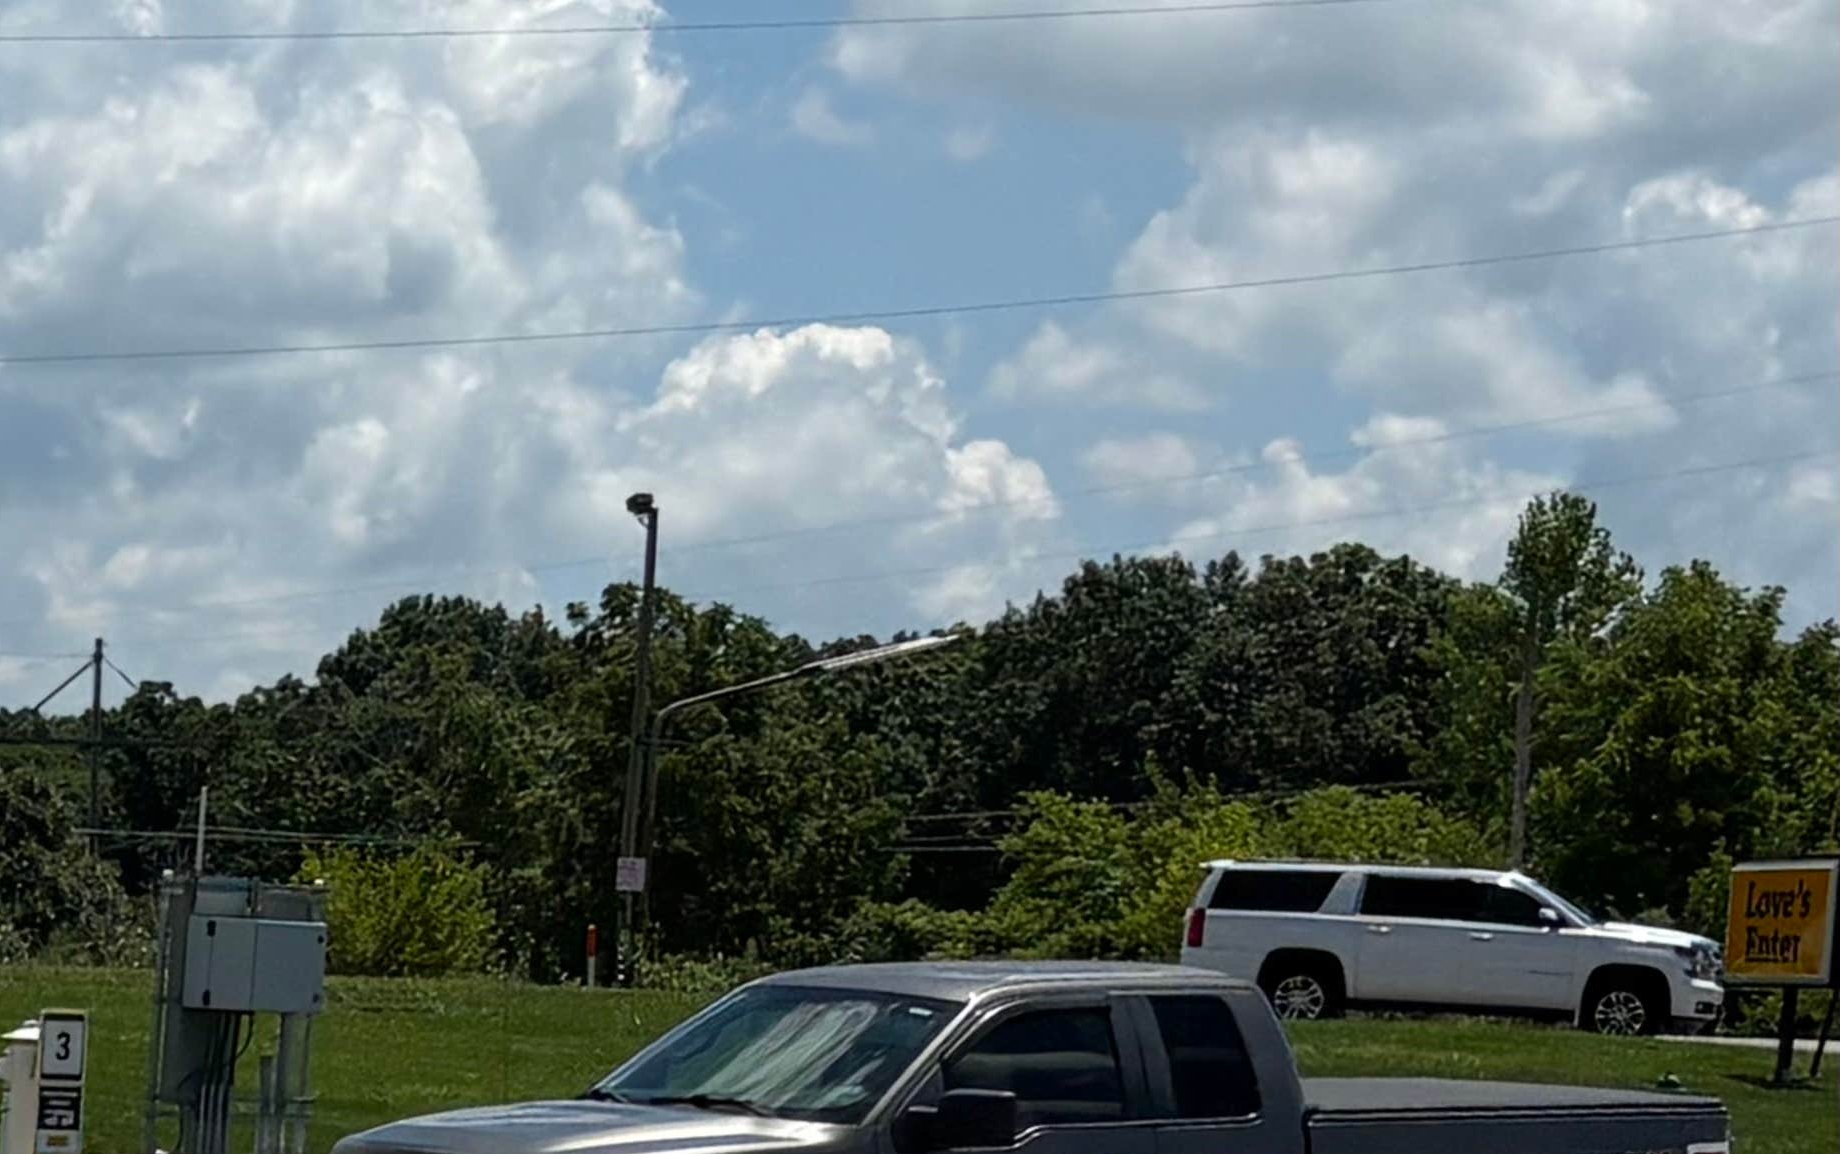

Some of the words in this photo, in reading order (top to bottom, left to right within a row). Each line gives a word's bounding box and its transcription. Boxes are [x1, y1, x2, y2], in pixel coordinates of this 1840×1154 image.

[1745, 879, 1811, 918] Love's
[1745, 925, 1801, 963] Enter
[55, 1032, 72, 1061] 3
